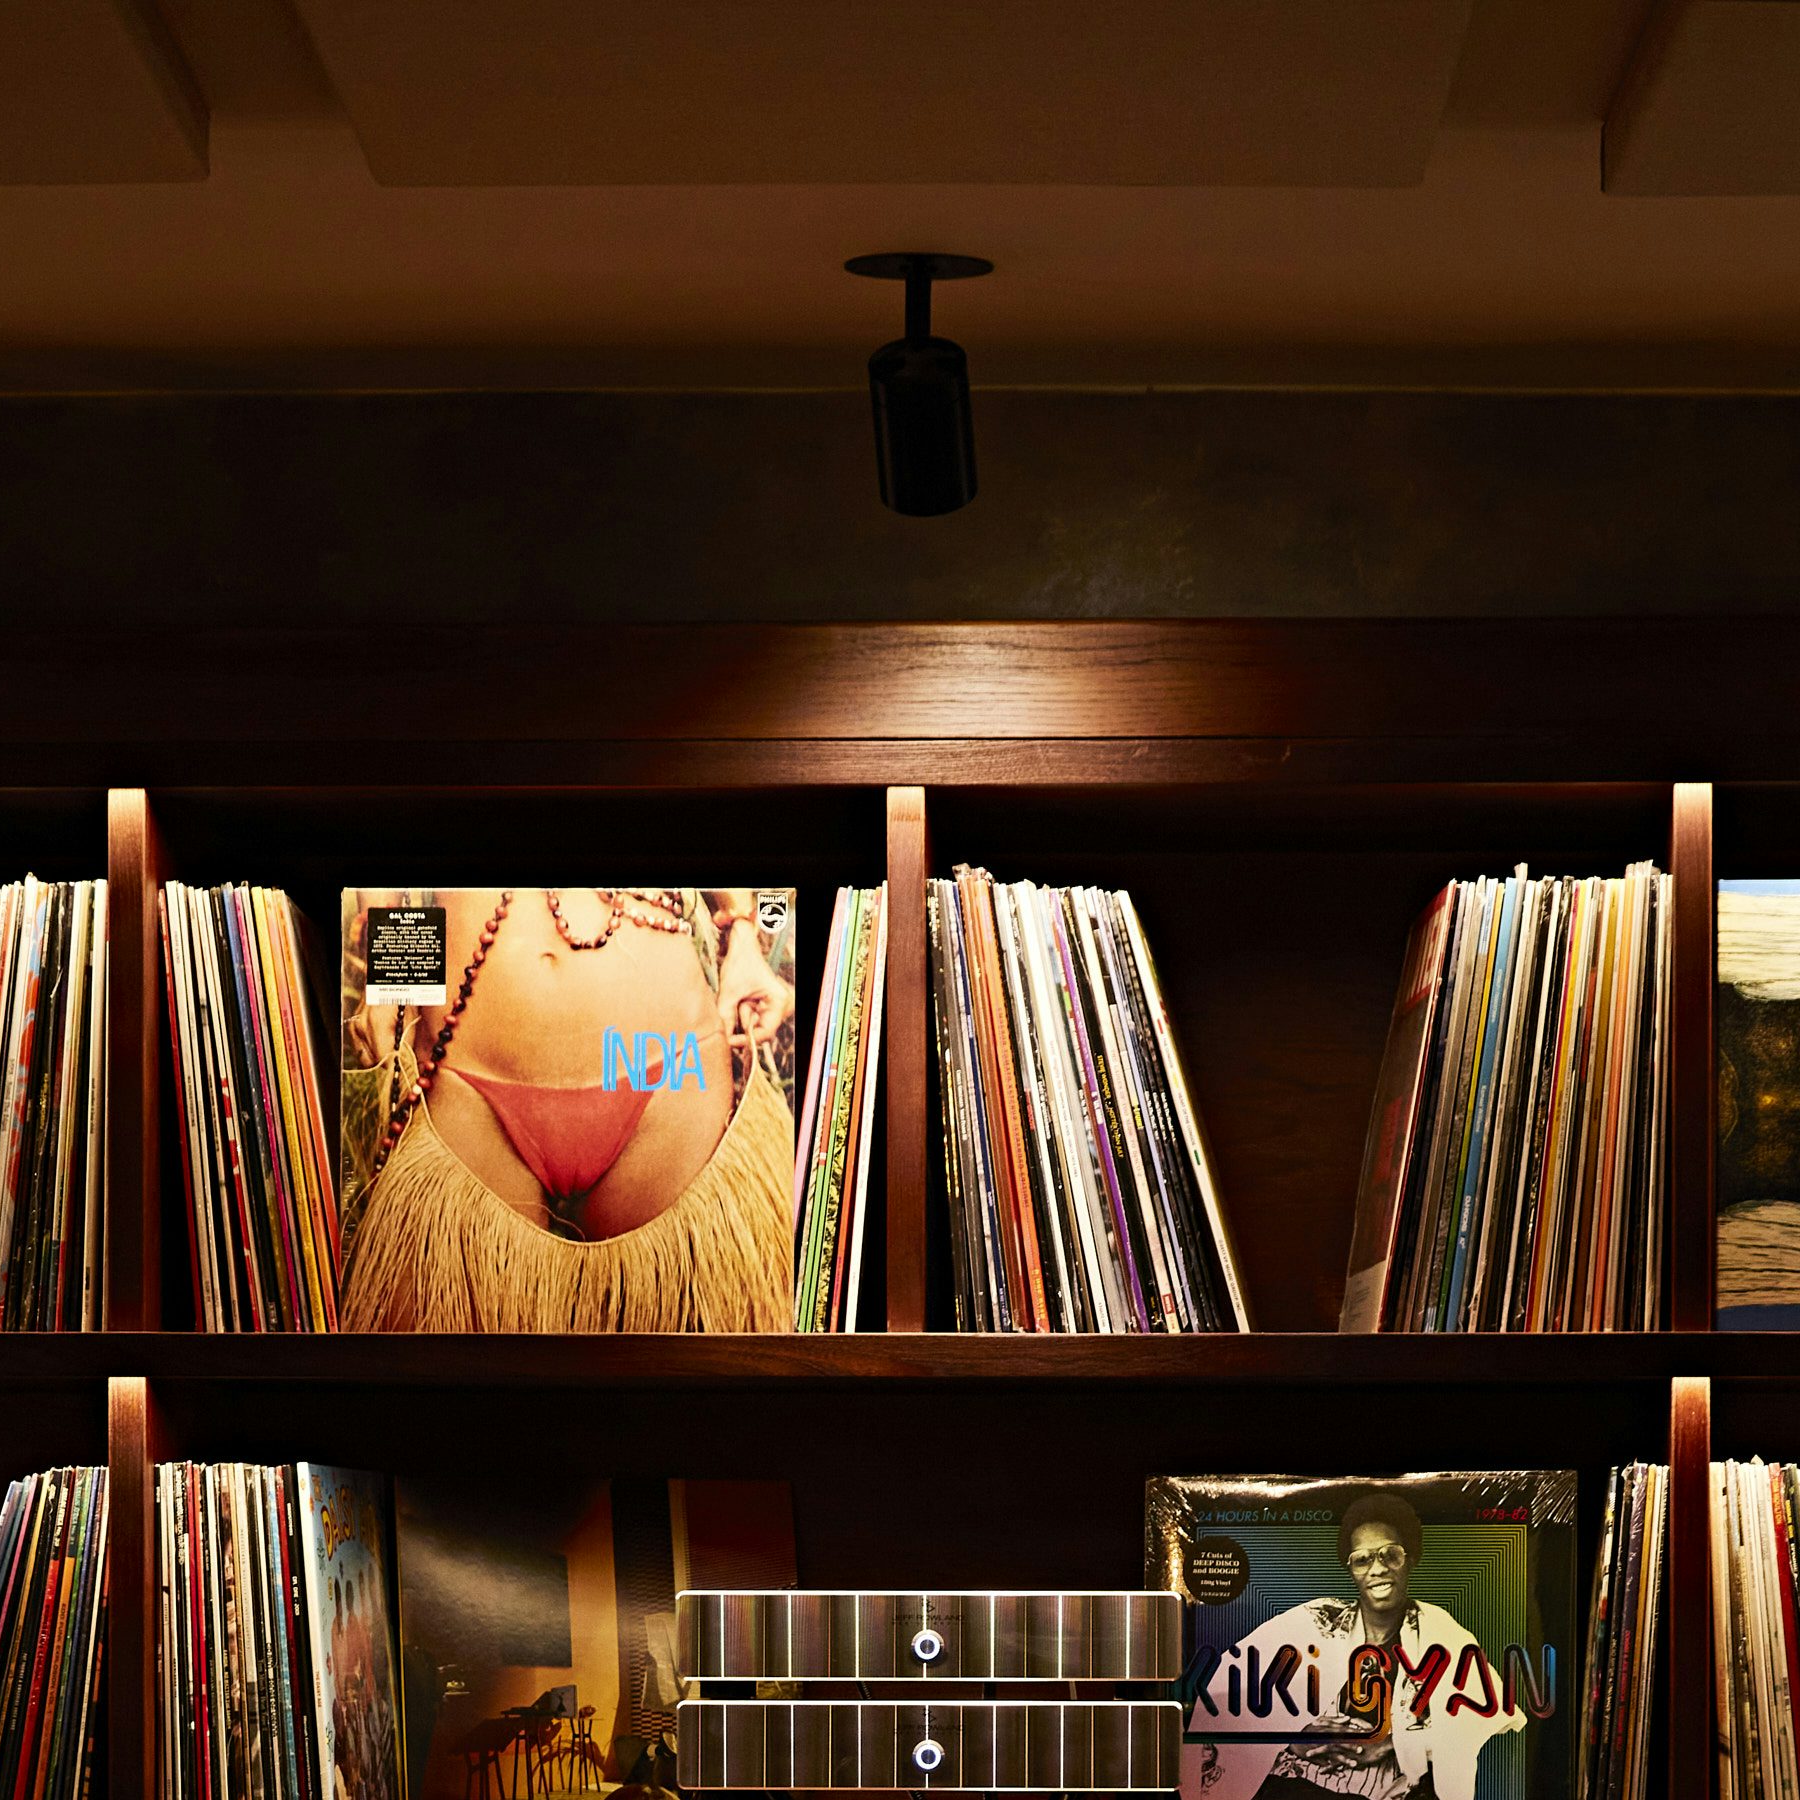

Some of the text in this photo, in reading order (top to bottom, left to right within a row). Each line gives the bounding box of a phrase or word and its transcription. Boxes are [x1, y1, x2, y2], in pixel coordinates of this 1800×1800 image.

[760, 896, 786, 904] PHILIPS
[1096, 1054, 1124, 1158] STEVIE WONDER HOTTER THAN JULY
[1199, 1510, 1333, 1522] 24 HOURS IN A DISCO
[1193, 1559, 1240, 1567] DEEP DISCO
[1192, 1567, 1239, 1575] and BOOGIE
